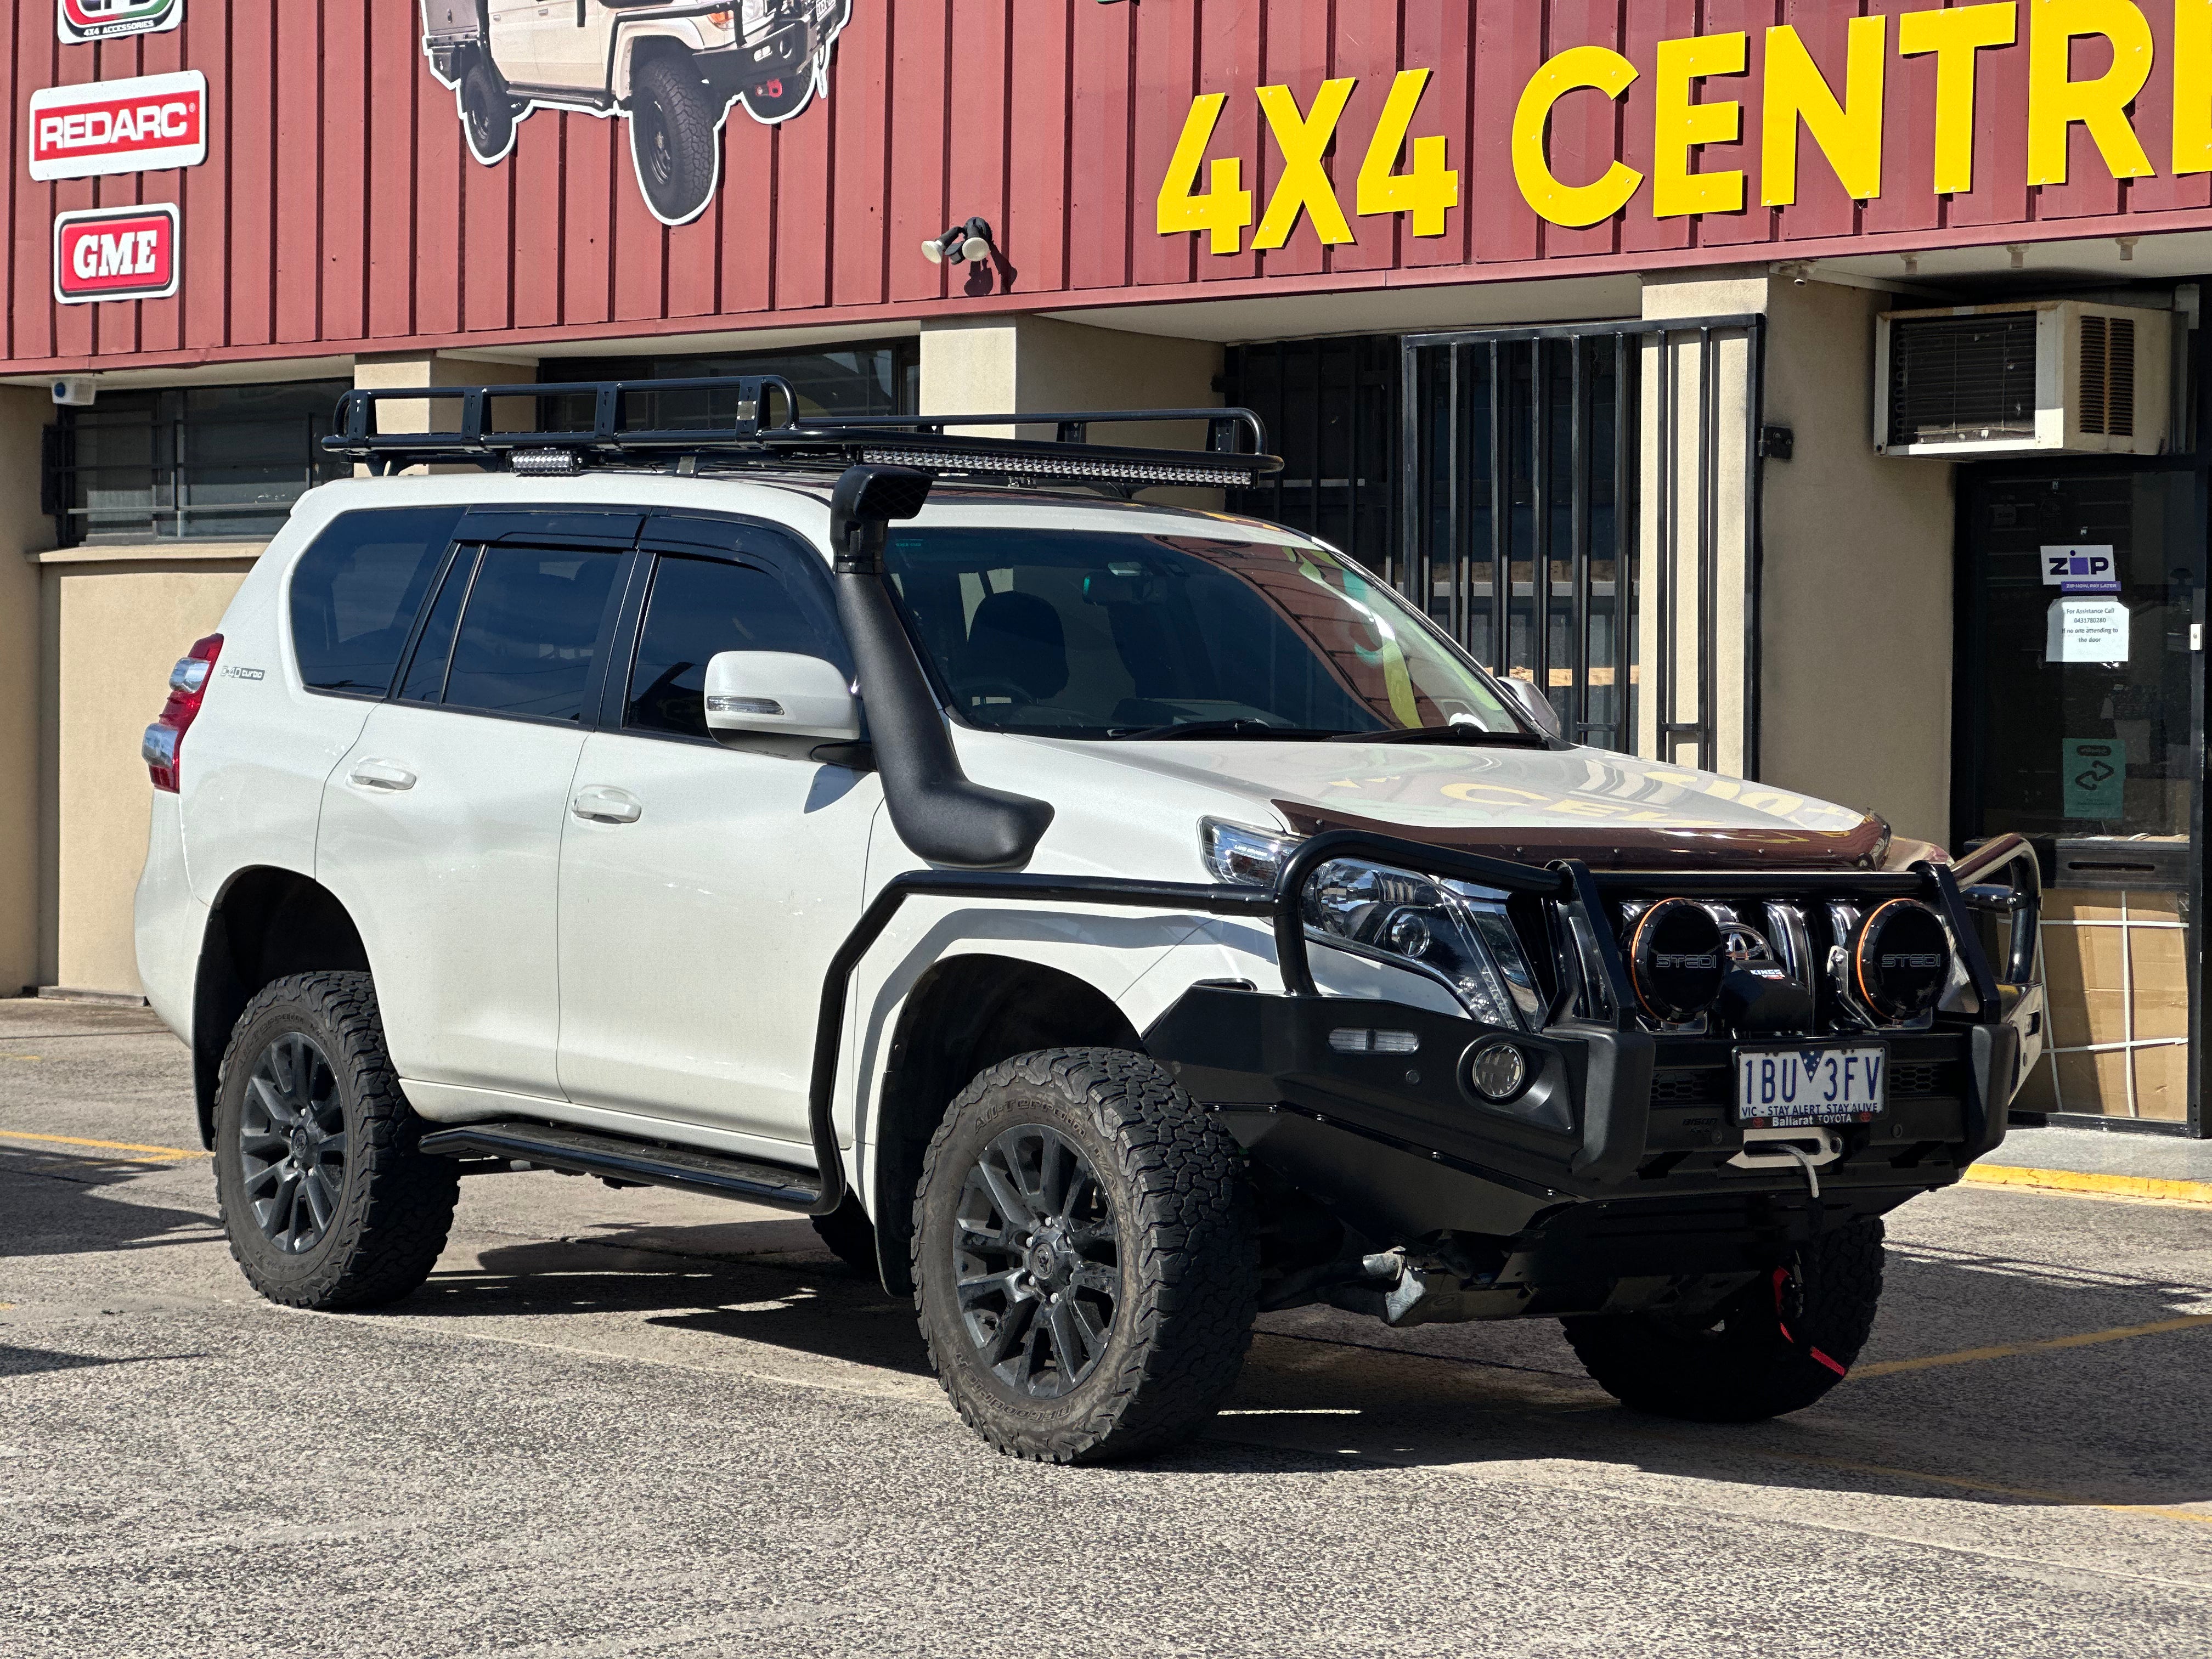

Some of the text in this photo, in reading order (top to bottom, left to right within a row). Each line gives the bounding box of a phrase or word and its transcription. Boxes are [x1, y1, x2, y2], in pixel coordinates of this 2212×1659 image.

[83, 20, 154, 36] 4X4 ACCESSORIES
[40, 102, 188, 151] REDARC
[1156, 67, 1459, 255] 4X4
[73, 229, 157, 279] GME
[241, 669, 263, 679] turbo
[1656, 955, 1716, 968] STEDI
[1881, 954, 1940, 967] STEDI
[1745, 1057, 1880, 1105] 1BU 3FV
[1742, 1106, 1757, 1117] VIC
[1768, 1105, 1790, 1116] STAY
[1792, 1104, 1821, 1115] ALERT
[1827, 1103, 1850, 1114] STAY
[1772, 1113, 1852, 1126] Ballarat TOYOTA
